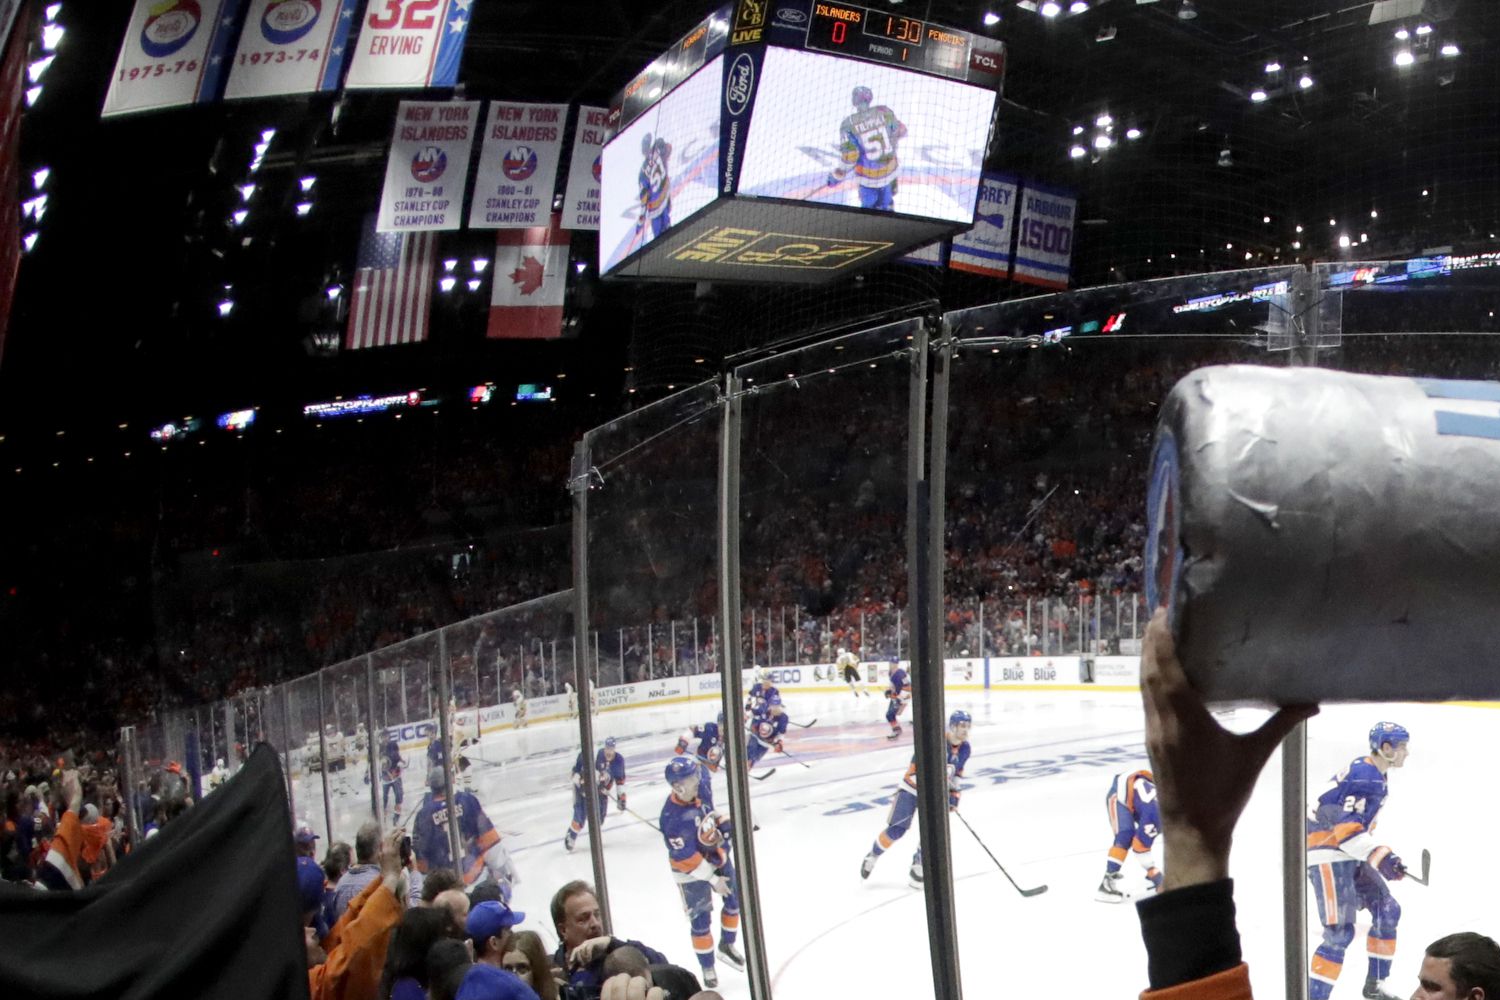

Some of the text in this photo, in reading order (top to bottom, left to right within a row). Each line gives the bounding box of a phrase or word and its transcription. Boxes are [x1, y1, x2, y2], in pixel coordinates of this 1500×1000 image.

[815, 4, 861, 23] ISLANDERS
[731, 28, 762, 43] LIVE
[832, 21, 847, 44] 0
[368, 35, 424, 57] ERVING
[869, 43, 894, 56] PERIOD
[901, 48, 908, 61] 1
[239, 49, 320, 66] 1973-74
[973, 54, 998, 69] TCL
[118, 60, 199, 82] 1975-76
[729, 65, 750, 104] Ford
[405, 106, 471, 122] NEW YORK
[496, 106, 560, 123] NEW YORK
[400, 124, 469, 141] ISLANDERS
[491, 126, 558, 142] ISLANDERS
[860, 127, 894, 161] 51
[981, 185, 1012, 205] RREY
[394, 199, 450, 212] STANLEY CUP
[486, 198, 541, 210] STANLEY CUP
[1026, 197, 1072, 219] ARBOUR
[394, 214, 446, 227] CHAMPIONS
[486, 211, 537, 223] CHAMPIONS
[1020, 216, 1072, 256] 1500
[771, 669, 801, 684] EICO
[1003, 667, 1057, 681] Blue Blue
[1343, 795, 1367, 814] 24
